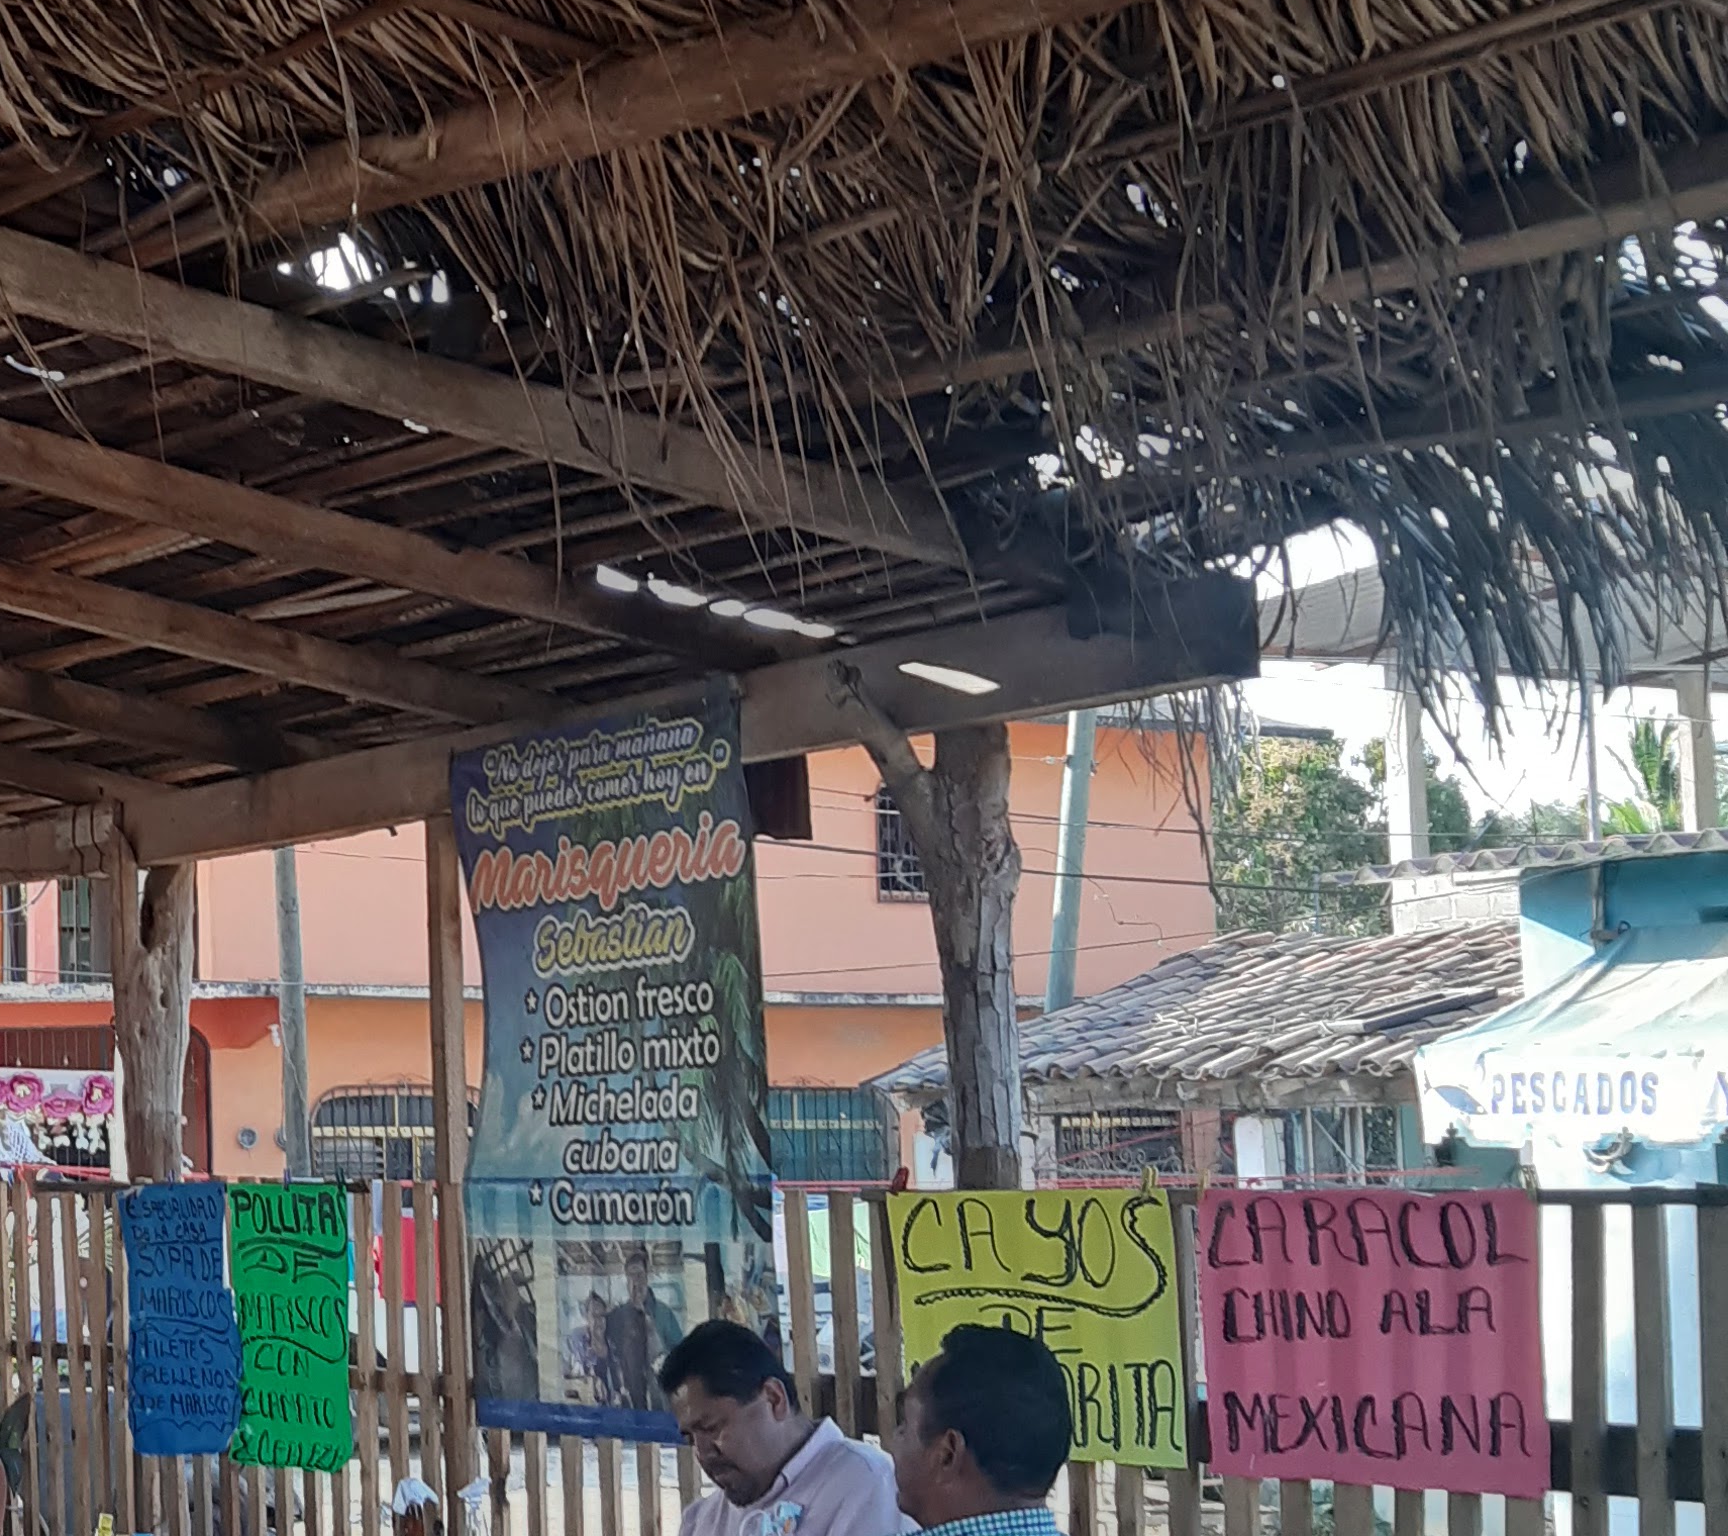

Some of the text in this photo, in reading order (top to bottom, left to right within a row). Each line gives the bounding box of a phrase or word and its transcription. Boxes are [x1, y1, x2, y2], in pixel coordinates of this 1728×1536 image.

[523, 747, 564, 791] dejes
[568, 738, 609, 776] para
[615, 725, 695, 759] mañana
[471, 795, 484, 825] lo
[488, 800, 520, 834] que
[523, 784, 582, 823] puedes
[644, 759, 679, 804] hoy
[471, 814, 744, 910] Marisqueria
[537, 909, 689, 970] Sebastian
[545, 976, 714, 1027] Ostion fresco
[540, 1027, 721, 1077] Platillo mixto
[550, 1078, 699, 1125] Michelada
[1491, 1071, 1659, 1115] PESCADOS
[564, 1130, 679, 1173] cubana
[550, 1180, 694, 1224] Camarón
[175, 1221, 209, 1243] CASA
[901, 1196, 1168, 1309] CAYOS
[1208, 1196, 1529, 1268] CARACOL
[135, 1244, 223, 1282] SOPA DE
[240, 1245, 341, 1290] DE
[139, 1285, 230, 1324] MARISCOS
[239, 1294, 346, 1342] MARISCOS
[1222, 1286, 1351, 1344] CHINO
[140, 1329, 213, 1364] FILETES
[254, 1343, 310, 1379] CON
[142, 1366, 236, 1390] RELLENOS
[1223, 1391, 1531, 1461] MEXICANA
